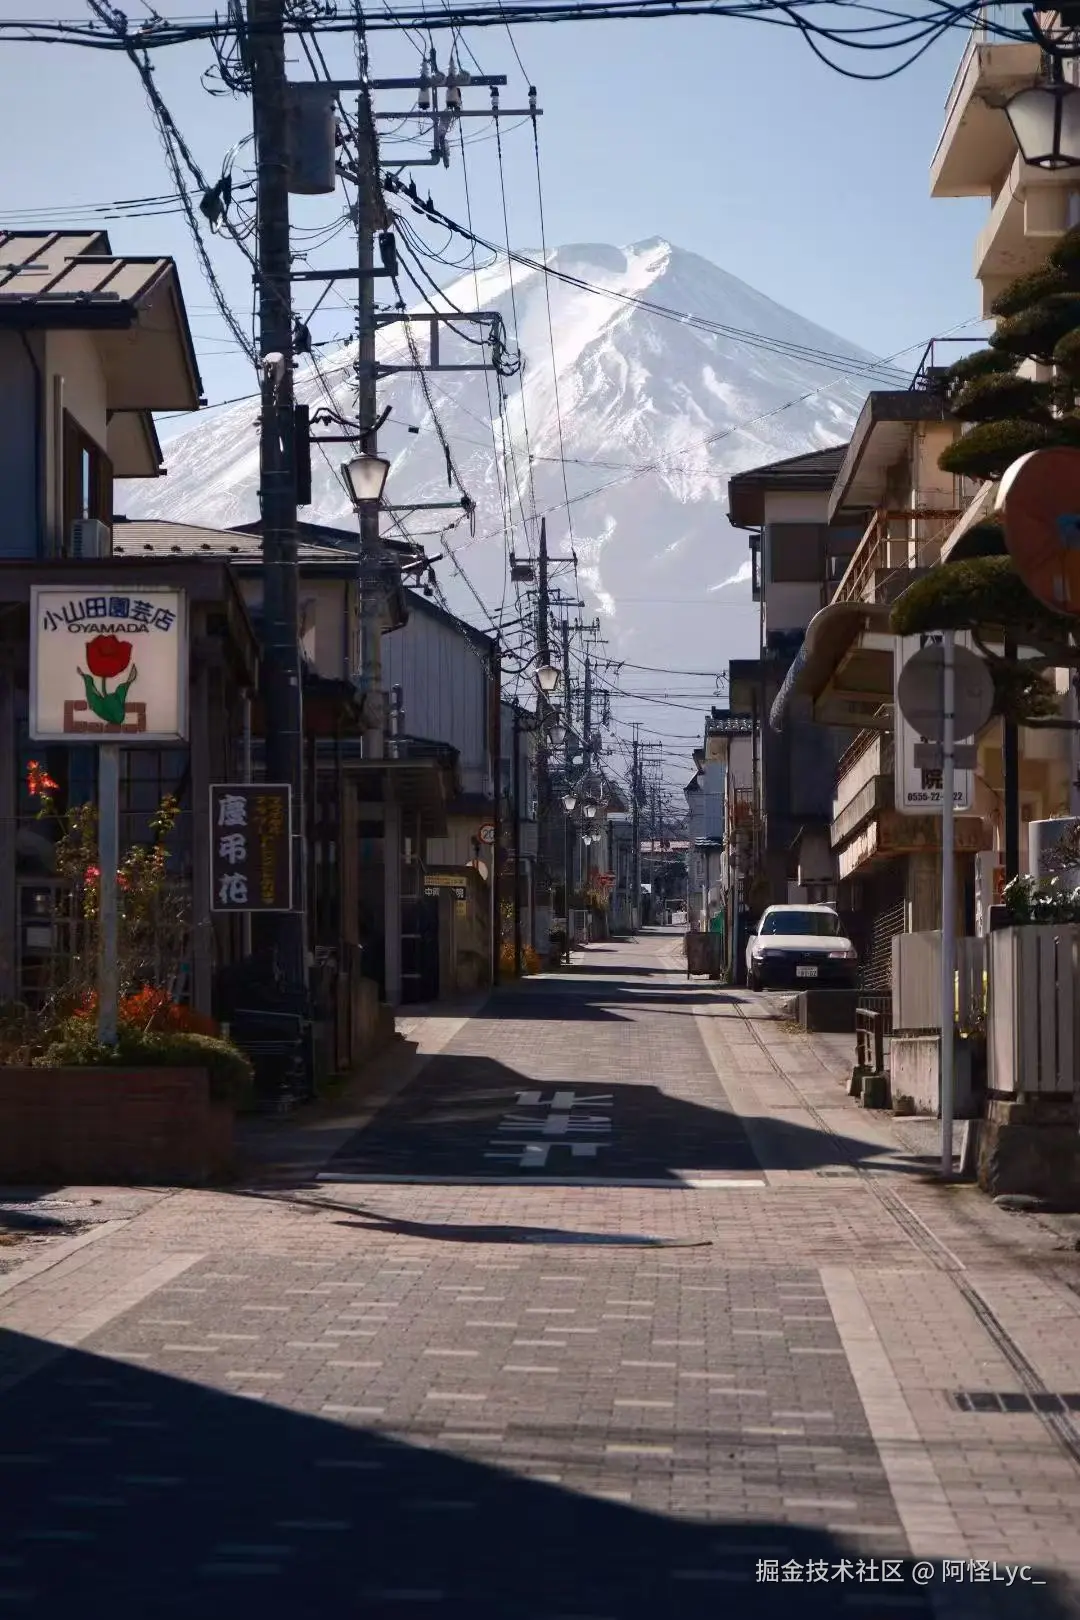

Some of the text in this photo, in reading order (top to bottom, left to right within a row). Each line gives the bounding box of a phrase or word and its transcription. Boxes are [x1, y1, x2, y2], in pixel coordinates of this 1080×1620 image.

[68, 623, 149, 633] OYAMADA
[907, 792, 963, 801] 0555-22-22
[483, 829, 495, 839] 20
